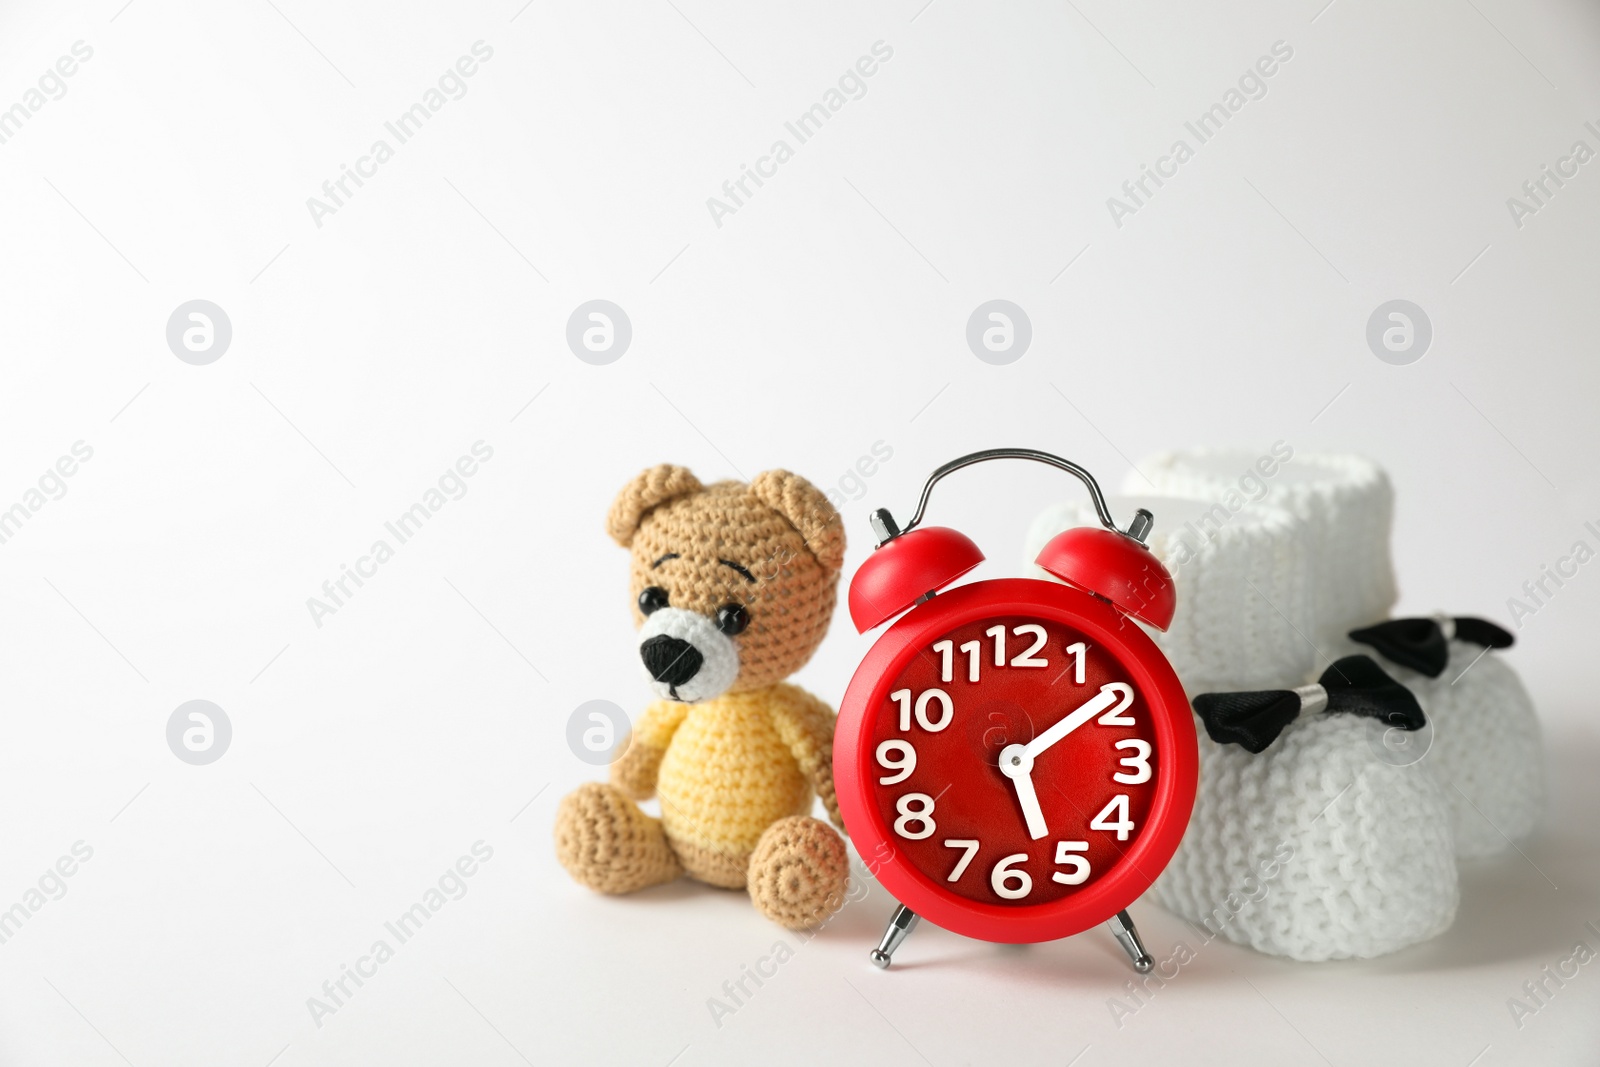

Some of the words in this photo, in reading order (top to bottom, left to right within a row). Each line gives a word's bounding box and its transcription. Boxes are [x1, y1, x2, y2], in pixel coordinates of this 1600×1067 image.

[933, 640, 980, 682] 11
[986, 624, 1049, 667] 12
[1066, 642, 1086, 684] 1
[890, 688, 954, 732] 10
[1098, 682, 1136, 726] 2
[875, 739, 917, 786] 9
[1113, 739, 1152, 785] 3
[893, 793, 936, 840] 8
[1090, 795, 1135, 841] 4
[944, 840, 980, 882] 7
[991, 853, 1033, 900] 6
[1052, 841, 1091, 886] 5
